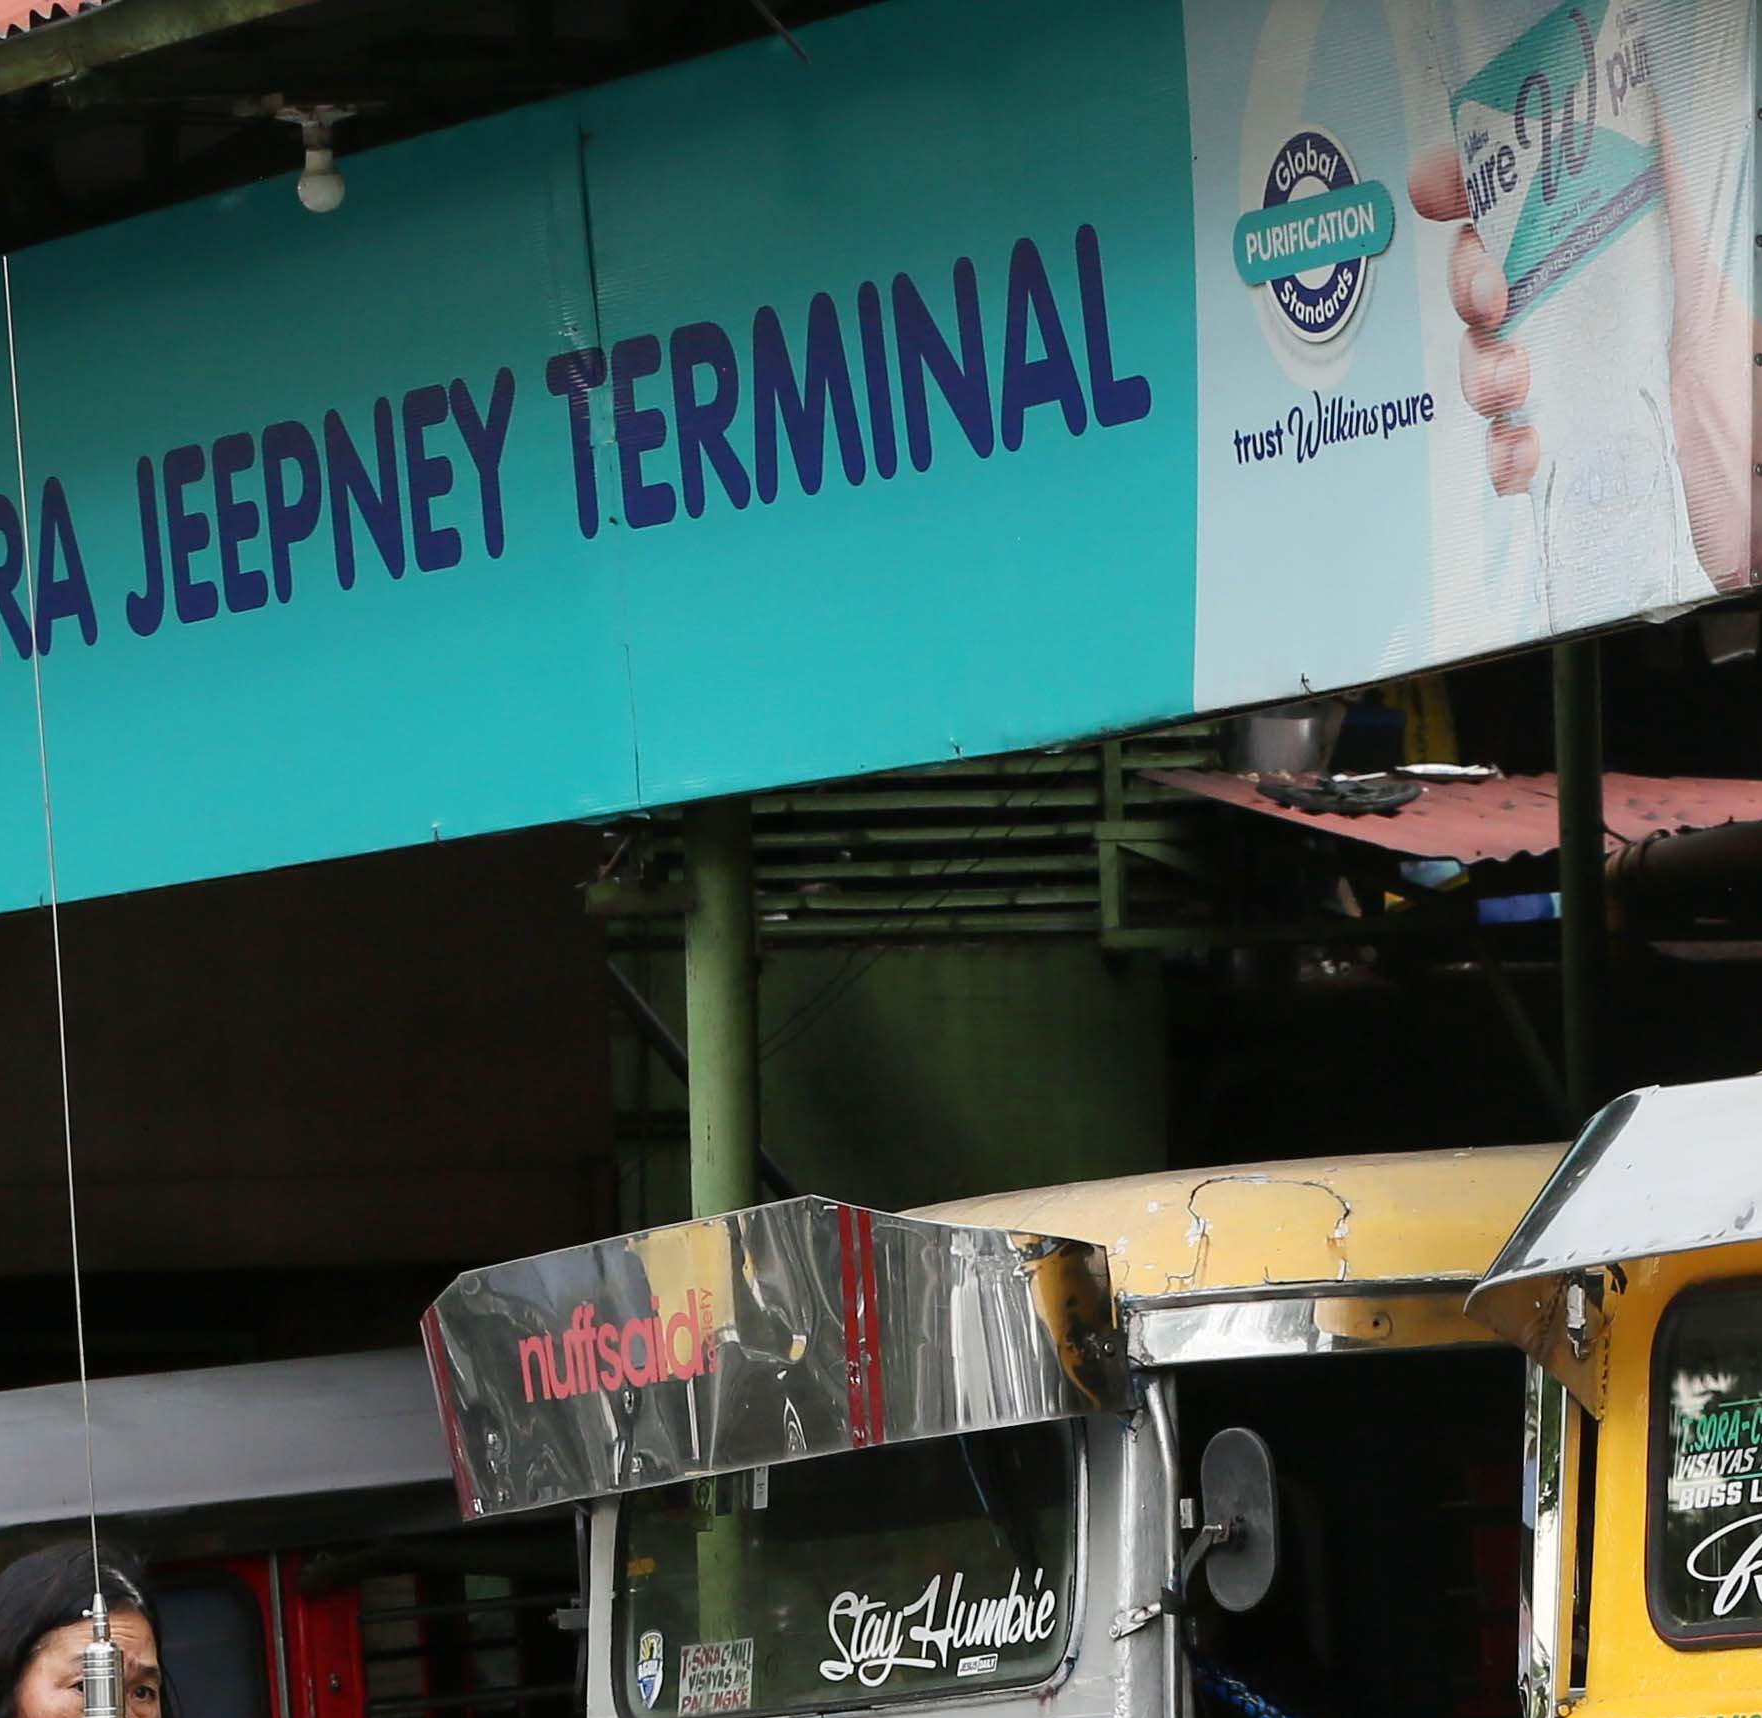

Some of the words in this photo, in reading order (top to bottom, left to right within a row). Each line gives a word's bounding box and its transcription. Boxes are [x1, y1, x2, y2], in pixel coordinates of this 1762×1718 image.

[1274, 148, 1340, 187] Global
[1245, 200, 1376, 262] PURIFICATION
[1279, 266, 1355, 325] Standards
[125, 366, 516, 637] JEEPNEY
[545, 223, 1152, 540] TERMINAL
[1234, 418, 1284, 465] trust
[1288, 389, 1378, 464] Wilkins
[1382, 392, 1435, 441] pure
[519, 1289, 701, 1402] nuffsaid
[1677, 1447, 1758, 1481] VISAYAS
[1678, 1481, 1743, 1511] BOSS
[819, 1590, 936, 1687] Stay
